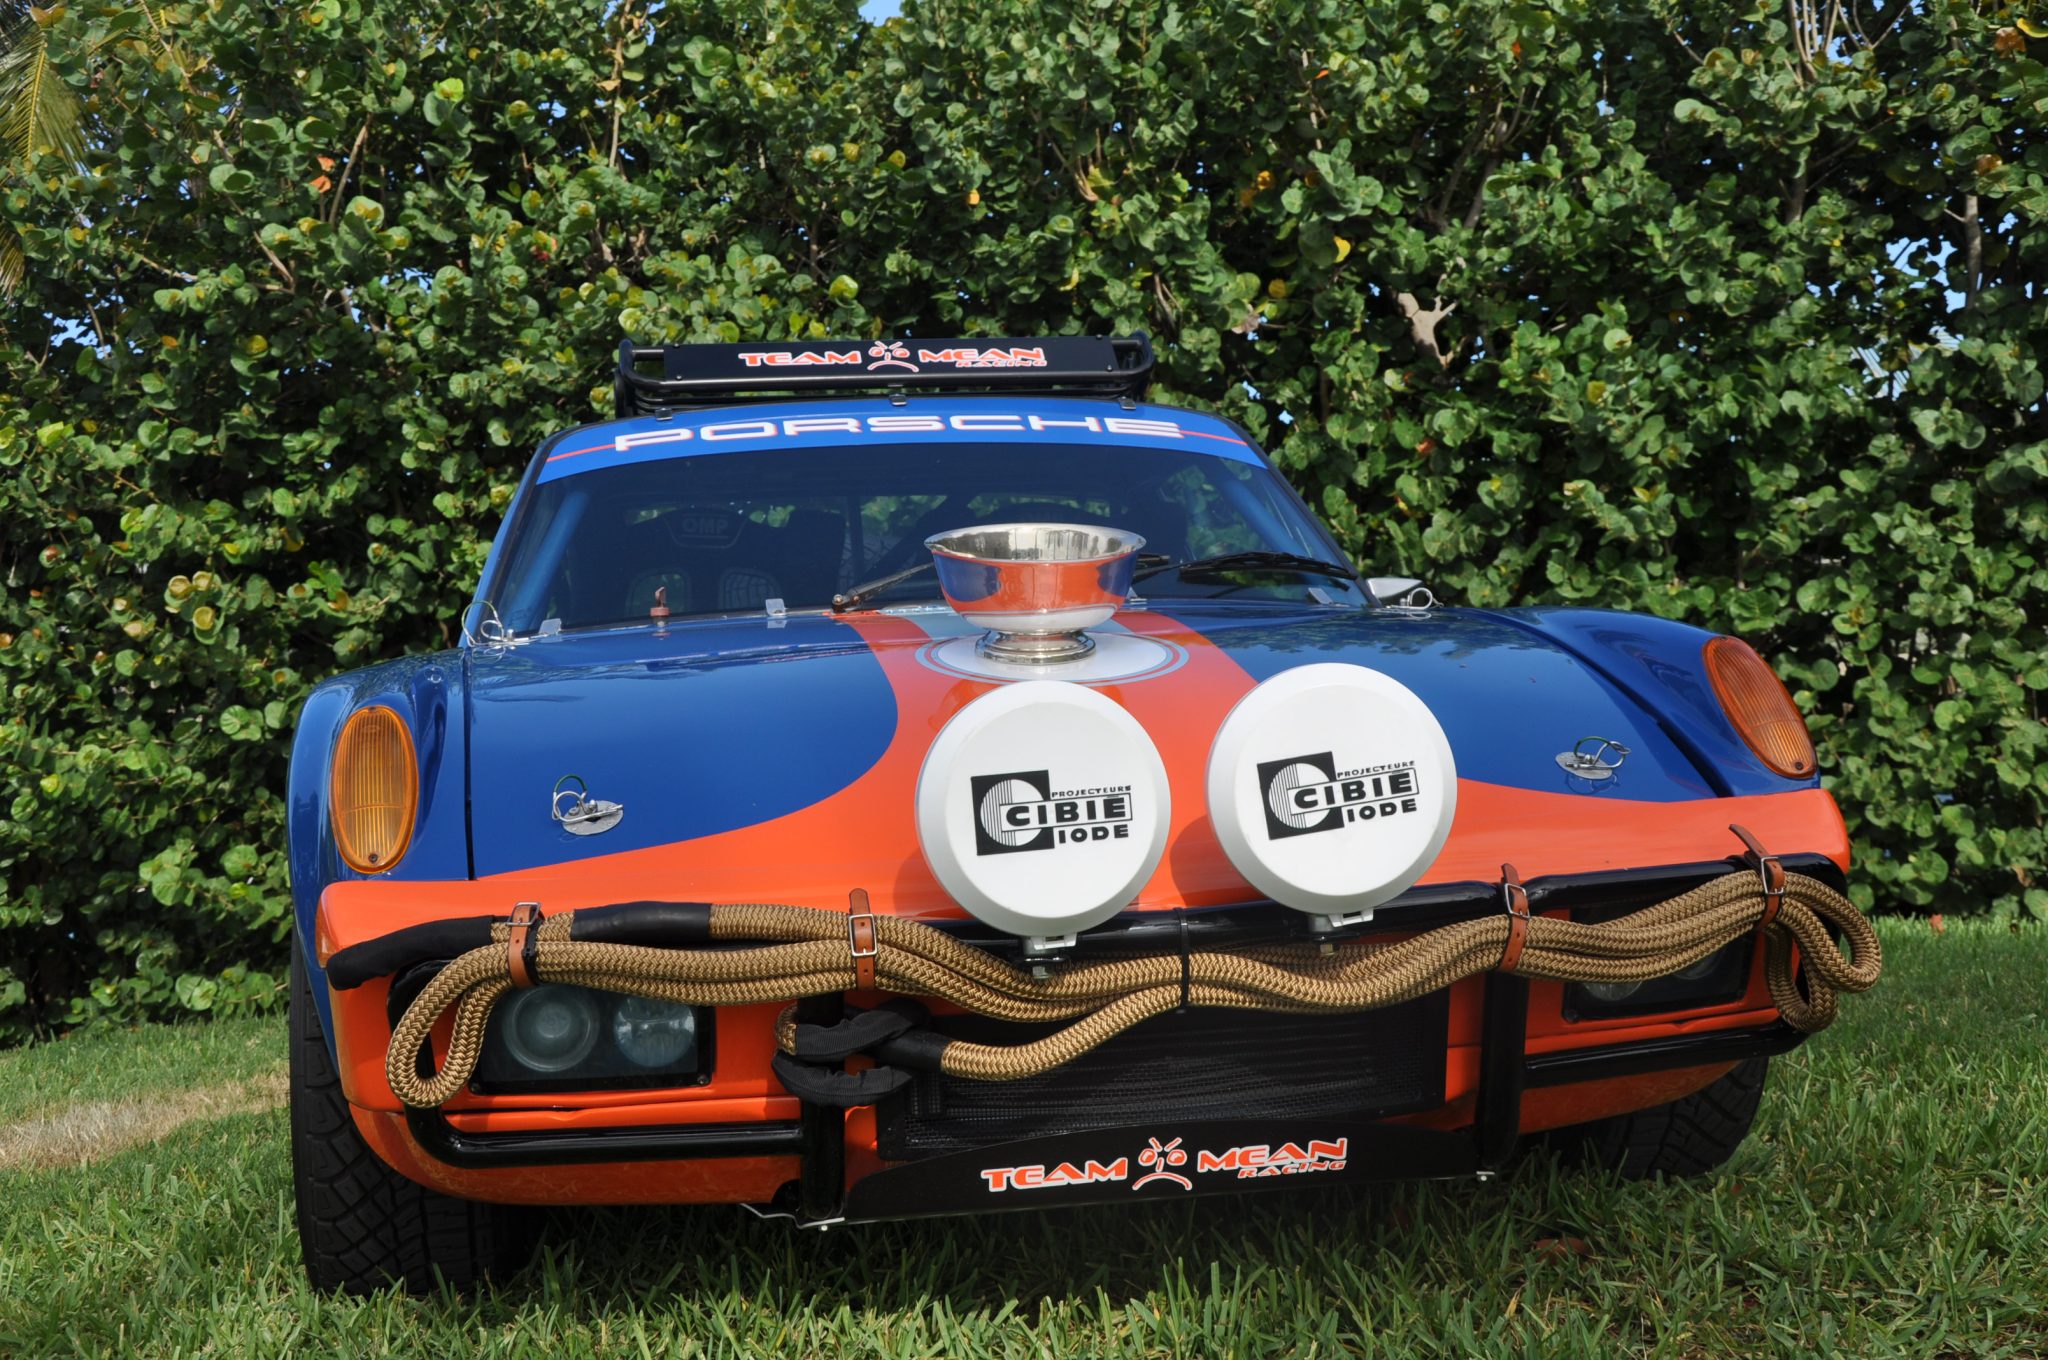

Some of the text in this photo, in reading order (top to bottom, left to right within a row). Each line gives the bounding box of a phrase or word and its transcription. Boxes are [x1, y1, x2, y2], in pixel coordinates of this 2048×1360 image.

[738, 347, 1045, 367] TEAM MEAN
[955, 359, 1048, 368] RACING
[614, 413, 1185, 454] PORSCHE
[681, 517, 729, 535] OMP
[1051, 784, 1132, 798] PROJECTEURS
[1347, 798, 1418, 823] IODE
[1058, 824, 1129, 844] IODE
[980, 1137, 1349, 1193] TEAM MEAN
[1237, 1160, 1347, 1179] RACING
